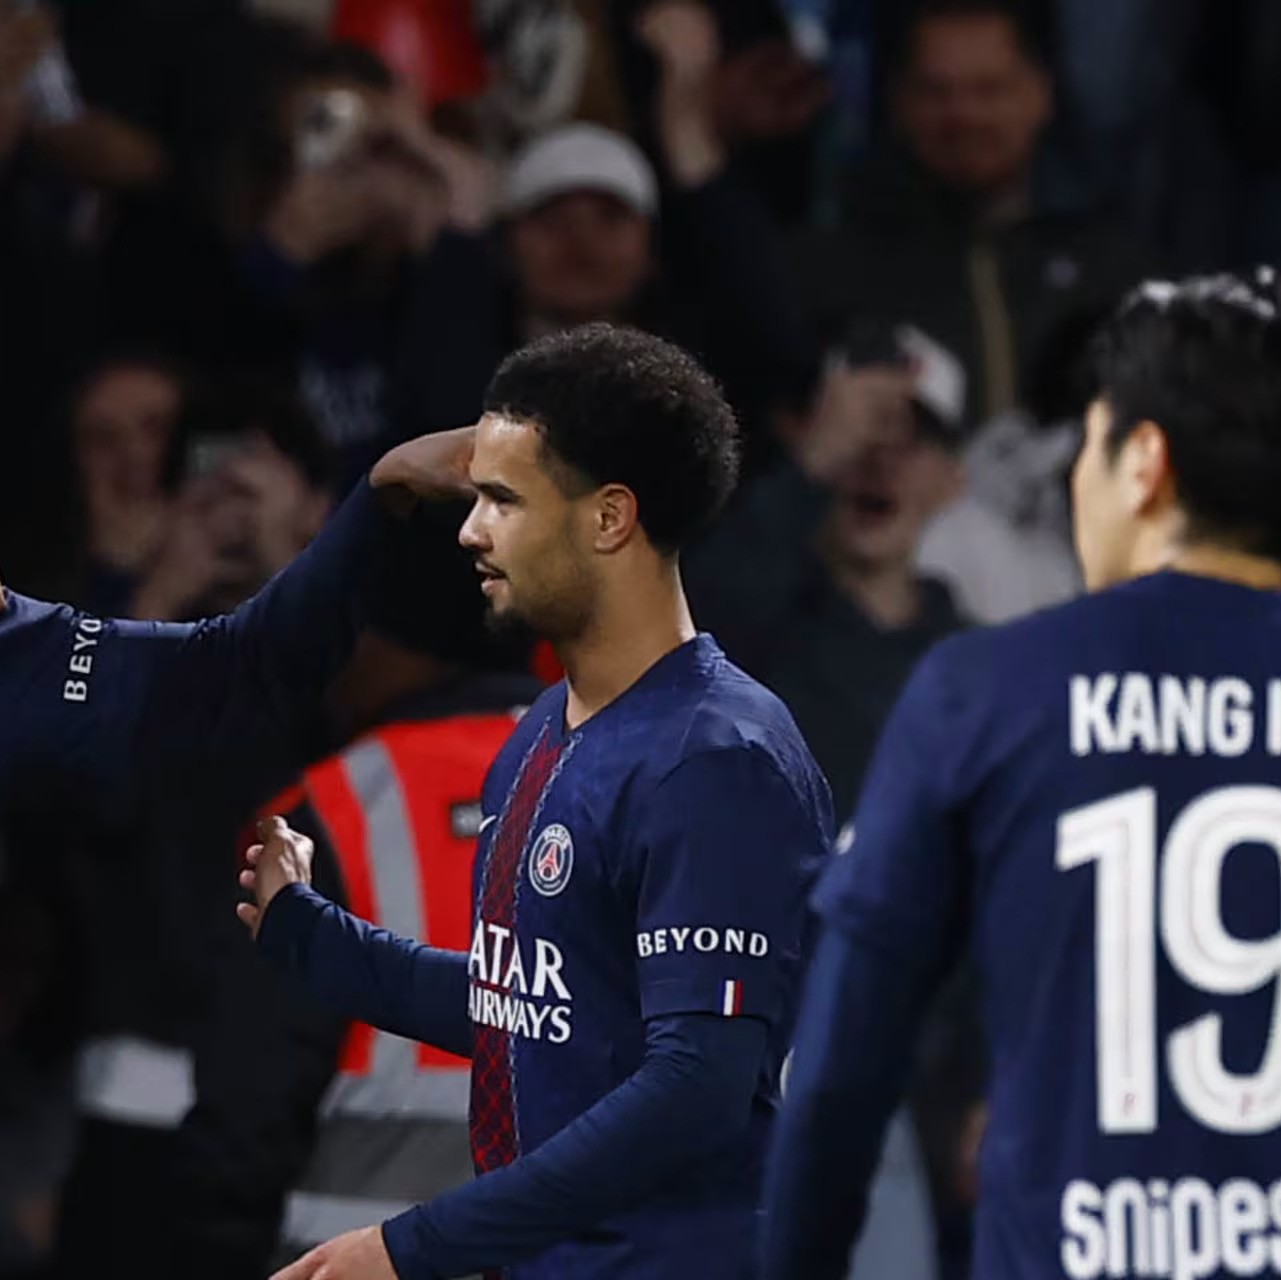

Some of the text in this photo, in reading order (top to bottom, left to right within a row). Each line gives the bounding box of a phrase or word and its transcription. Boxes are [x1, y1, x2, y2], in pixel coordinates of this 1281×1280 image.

[63, 619, 102, 701] BEYO
[1070, 672, 1254, 757] KANG
[468, 919, 573, 1000] ATAR
[637, 927, 768, 957] BEYOND
[468, 981, 571, 1043] AIRWAYS
